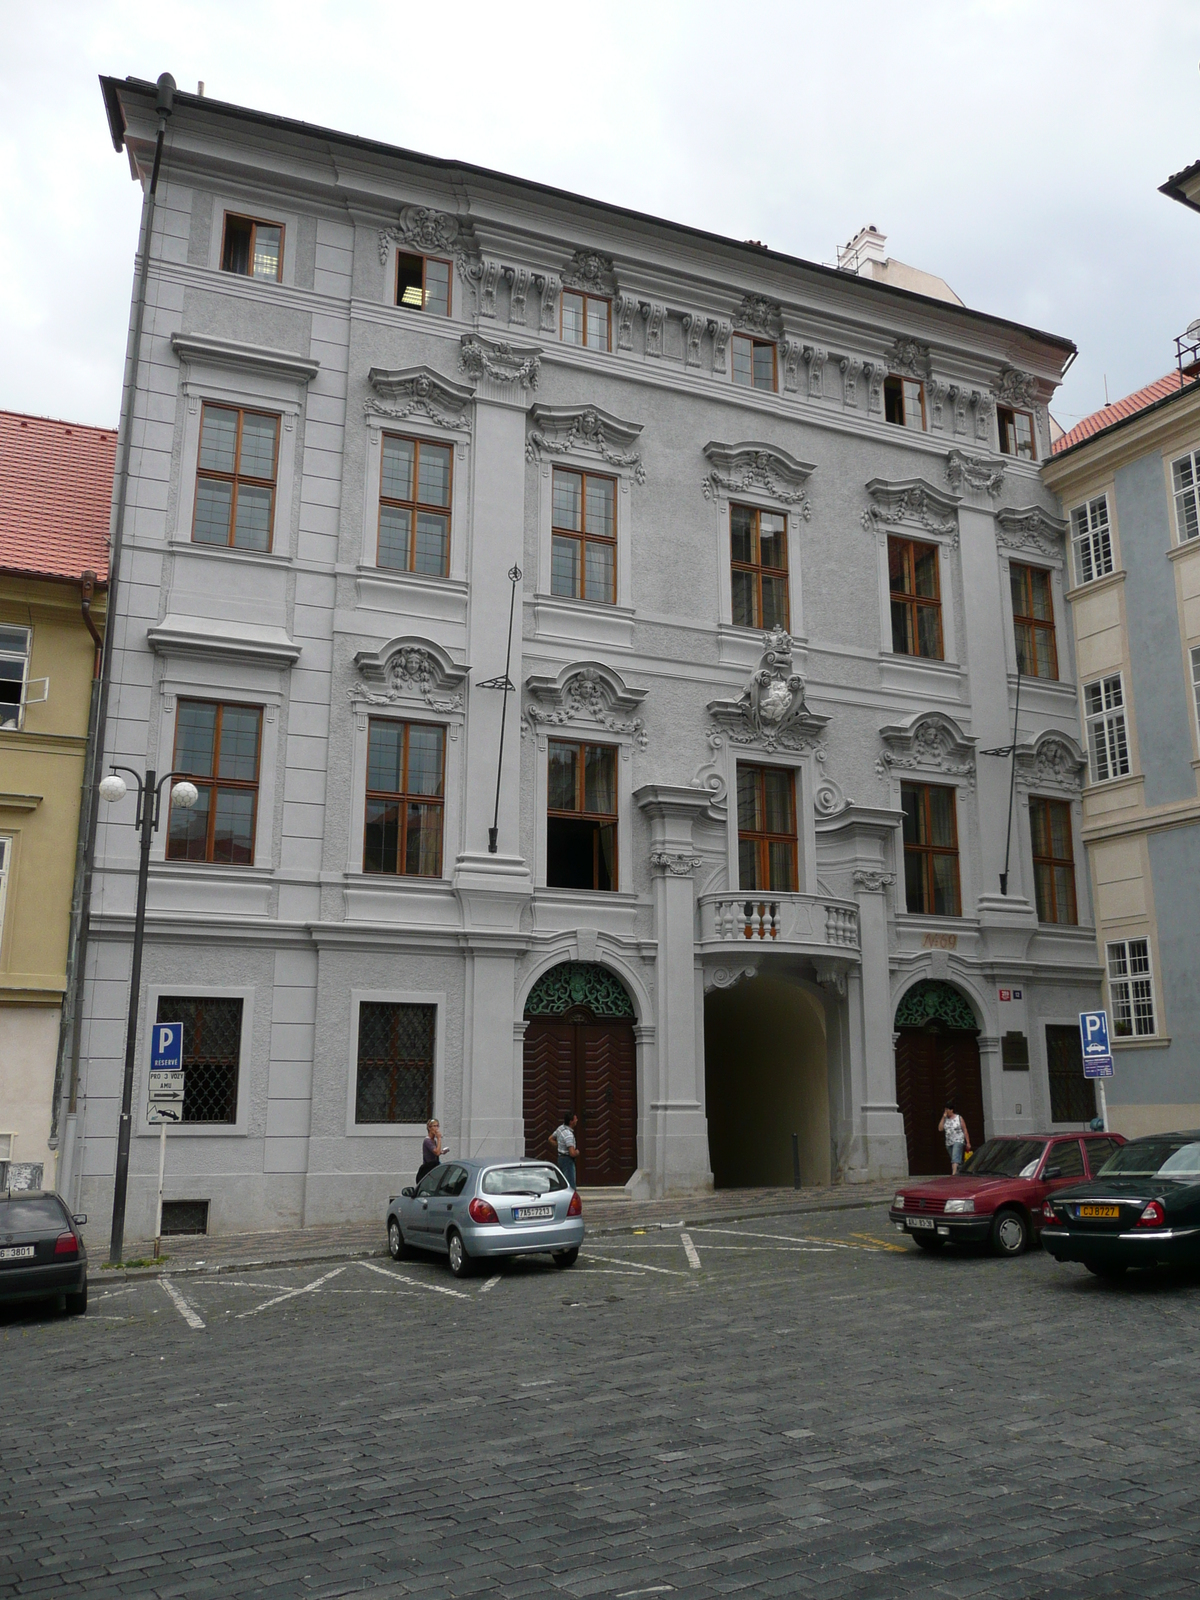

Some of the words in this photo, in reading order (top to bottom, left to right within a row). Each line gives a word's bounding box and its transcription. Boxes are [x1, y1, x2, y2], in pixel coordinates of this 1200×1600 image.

[1086, 1015, 1100, 1040] P
[159, 1028, 173, 1053] P
[11, 1247, 31, 1257] 3801
